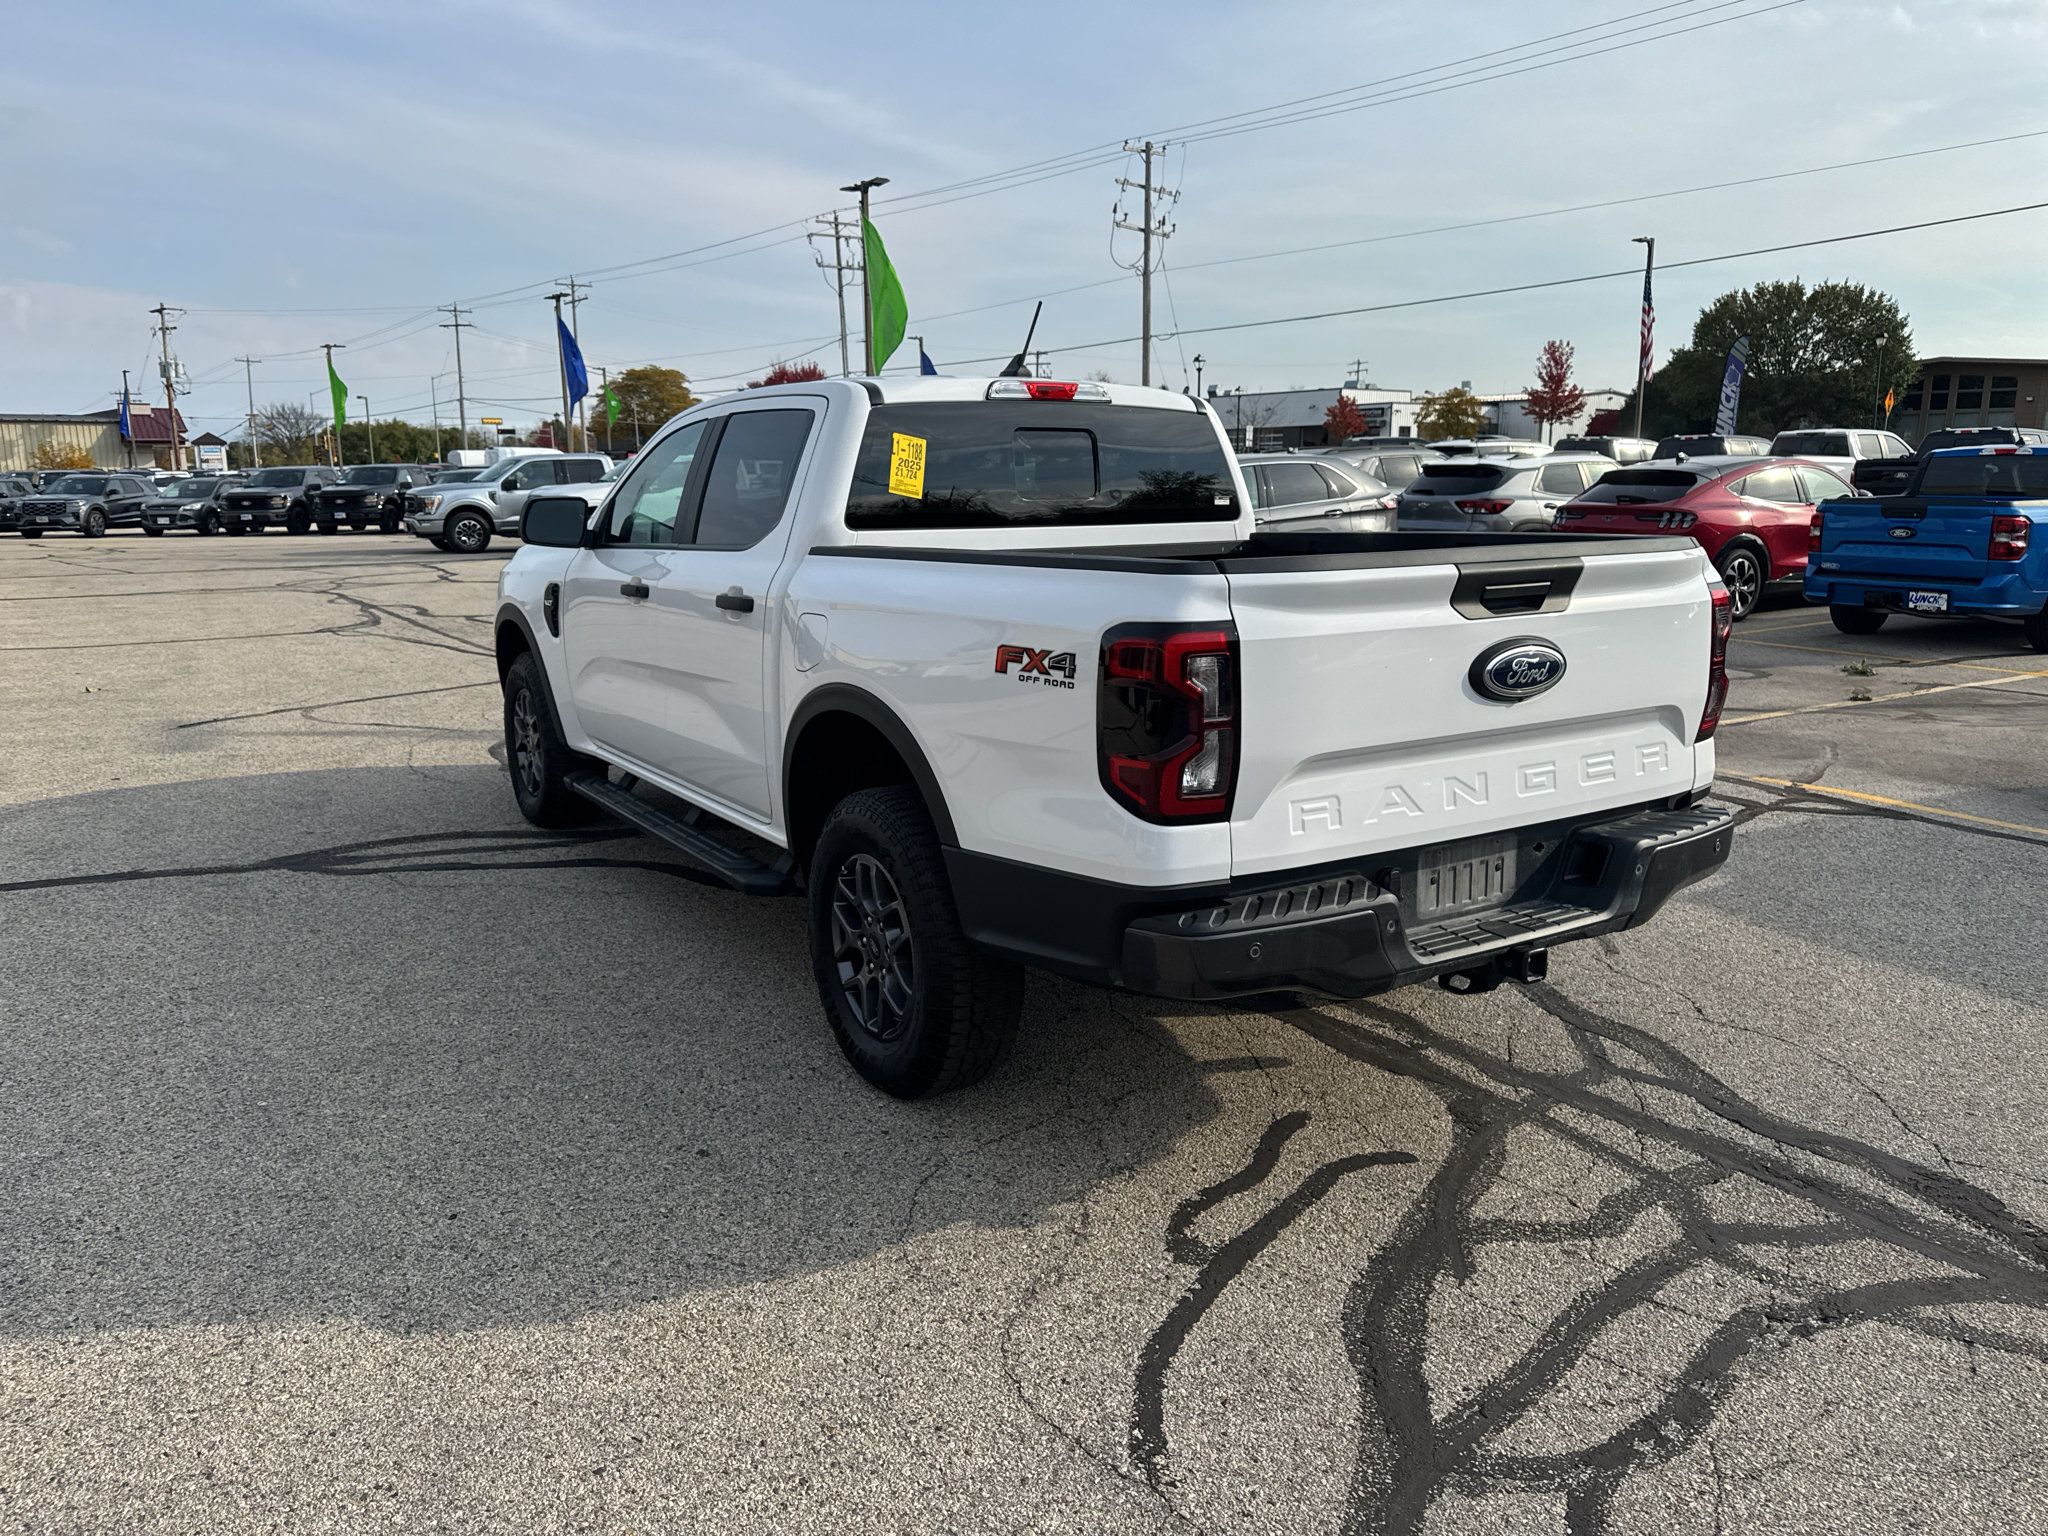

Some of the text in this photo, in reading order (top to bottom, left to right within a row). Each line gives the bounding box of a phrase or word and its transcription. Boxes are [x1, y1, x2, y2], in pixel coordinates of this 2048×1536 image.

[1715, 379, 1737, 435] YNCH
[895, 467, 917, 480] 21,724
[898, 457, 921, 471] 2025
[1909, 593, 1940, 604] LYNCH
[995, 644, 1077, 679] FX4
[1507, 657, 1550, 685] Ford
[1018, 674, 1075, 690] OFF ROAD
[1288, 741, 1669, 836] RANGER
